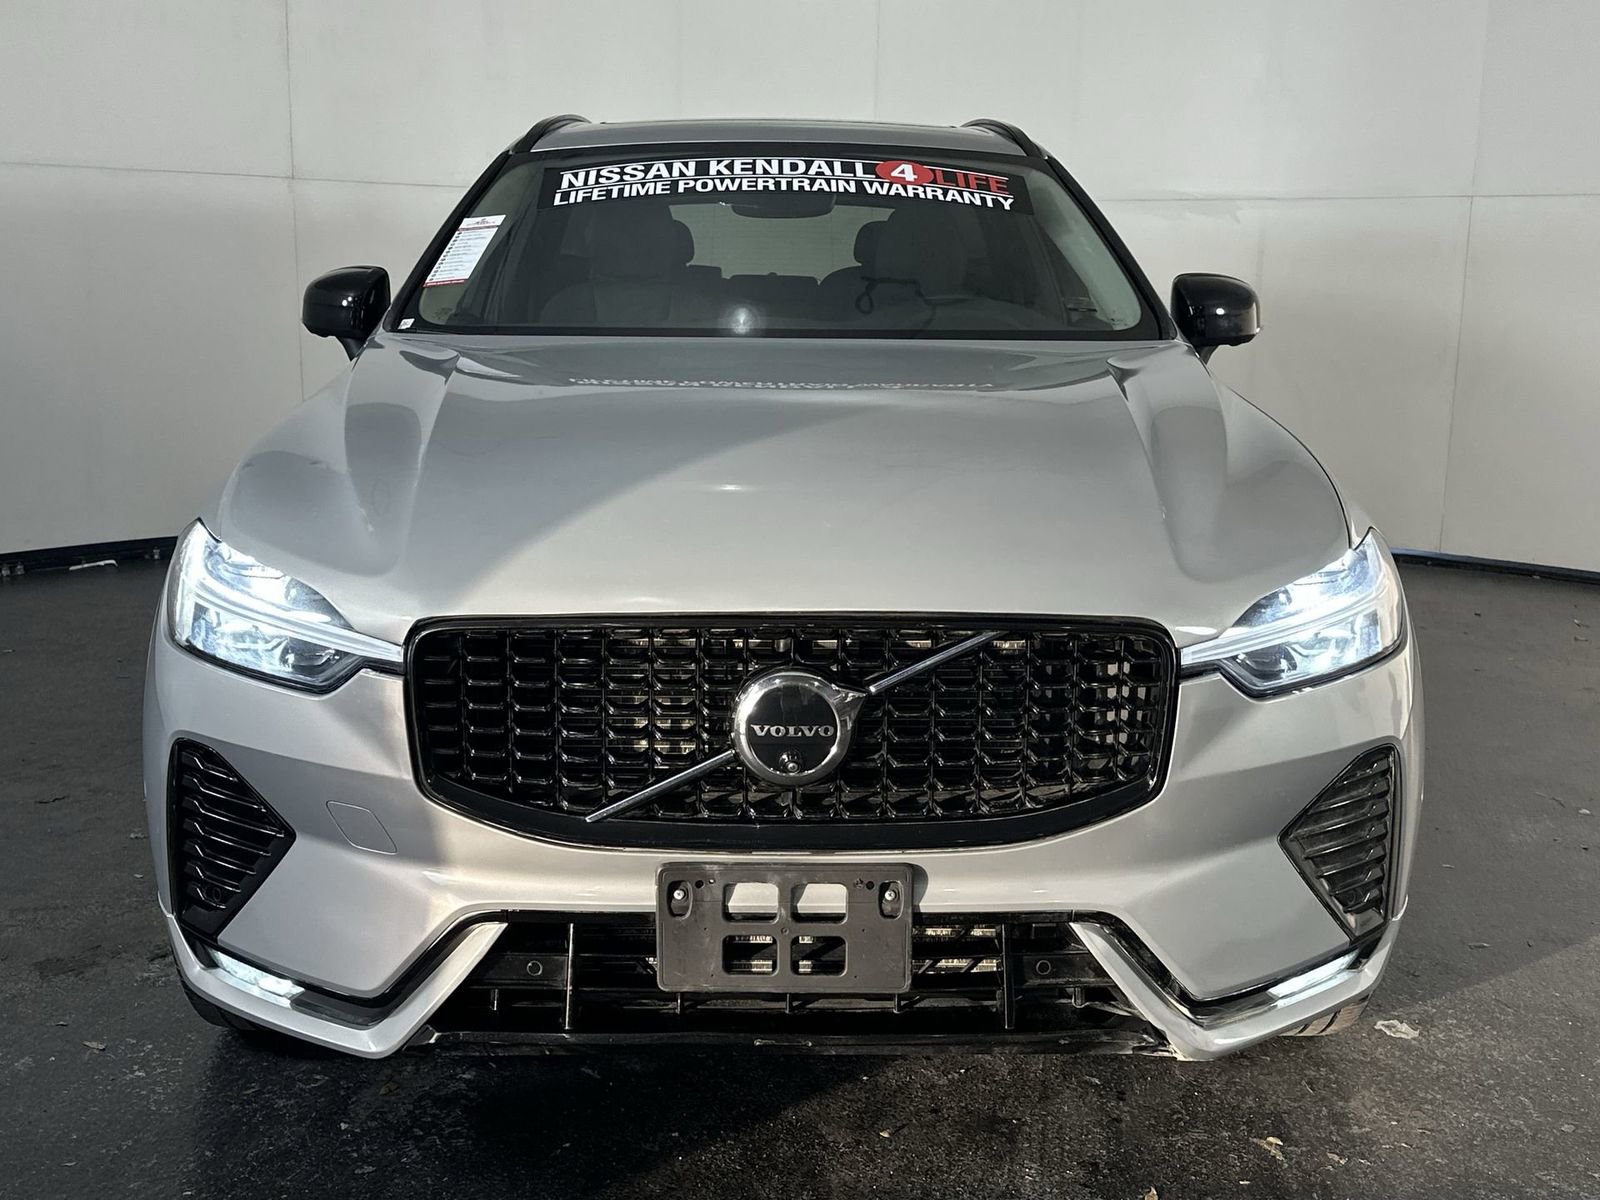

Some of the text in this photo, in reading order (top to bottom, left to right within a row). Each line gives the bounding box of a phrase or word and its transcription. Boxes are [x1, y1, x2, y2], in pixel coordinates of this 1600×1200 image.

[553, 177, 1015, 211] LIFETIME POWERTRAIN WARRANTY
[561, 159, 1010, 195] NISSAN KENDALL 4 LIFE
[750, 724, 835, 737] VOLVO
